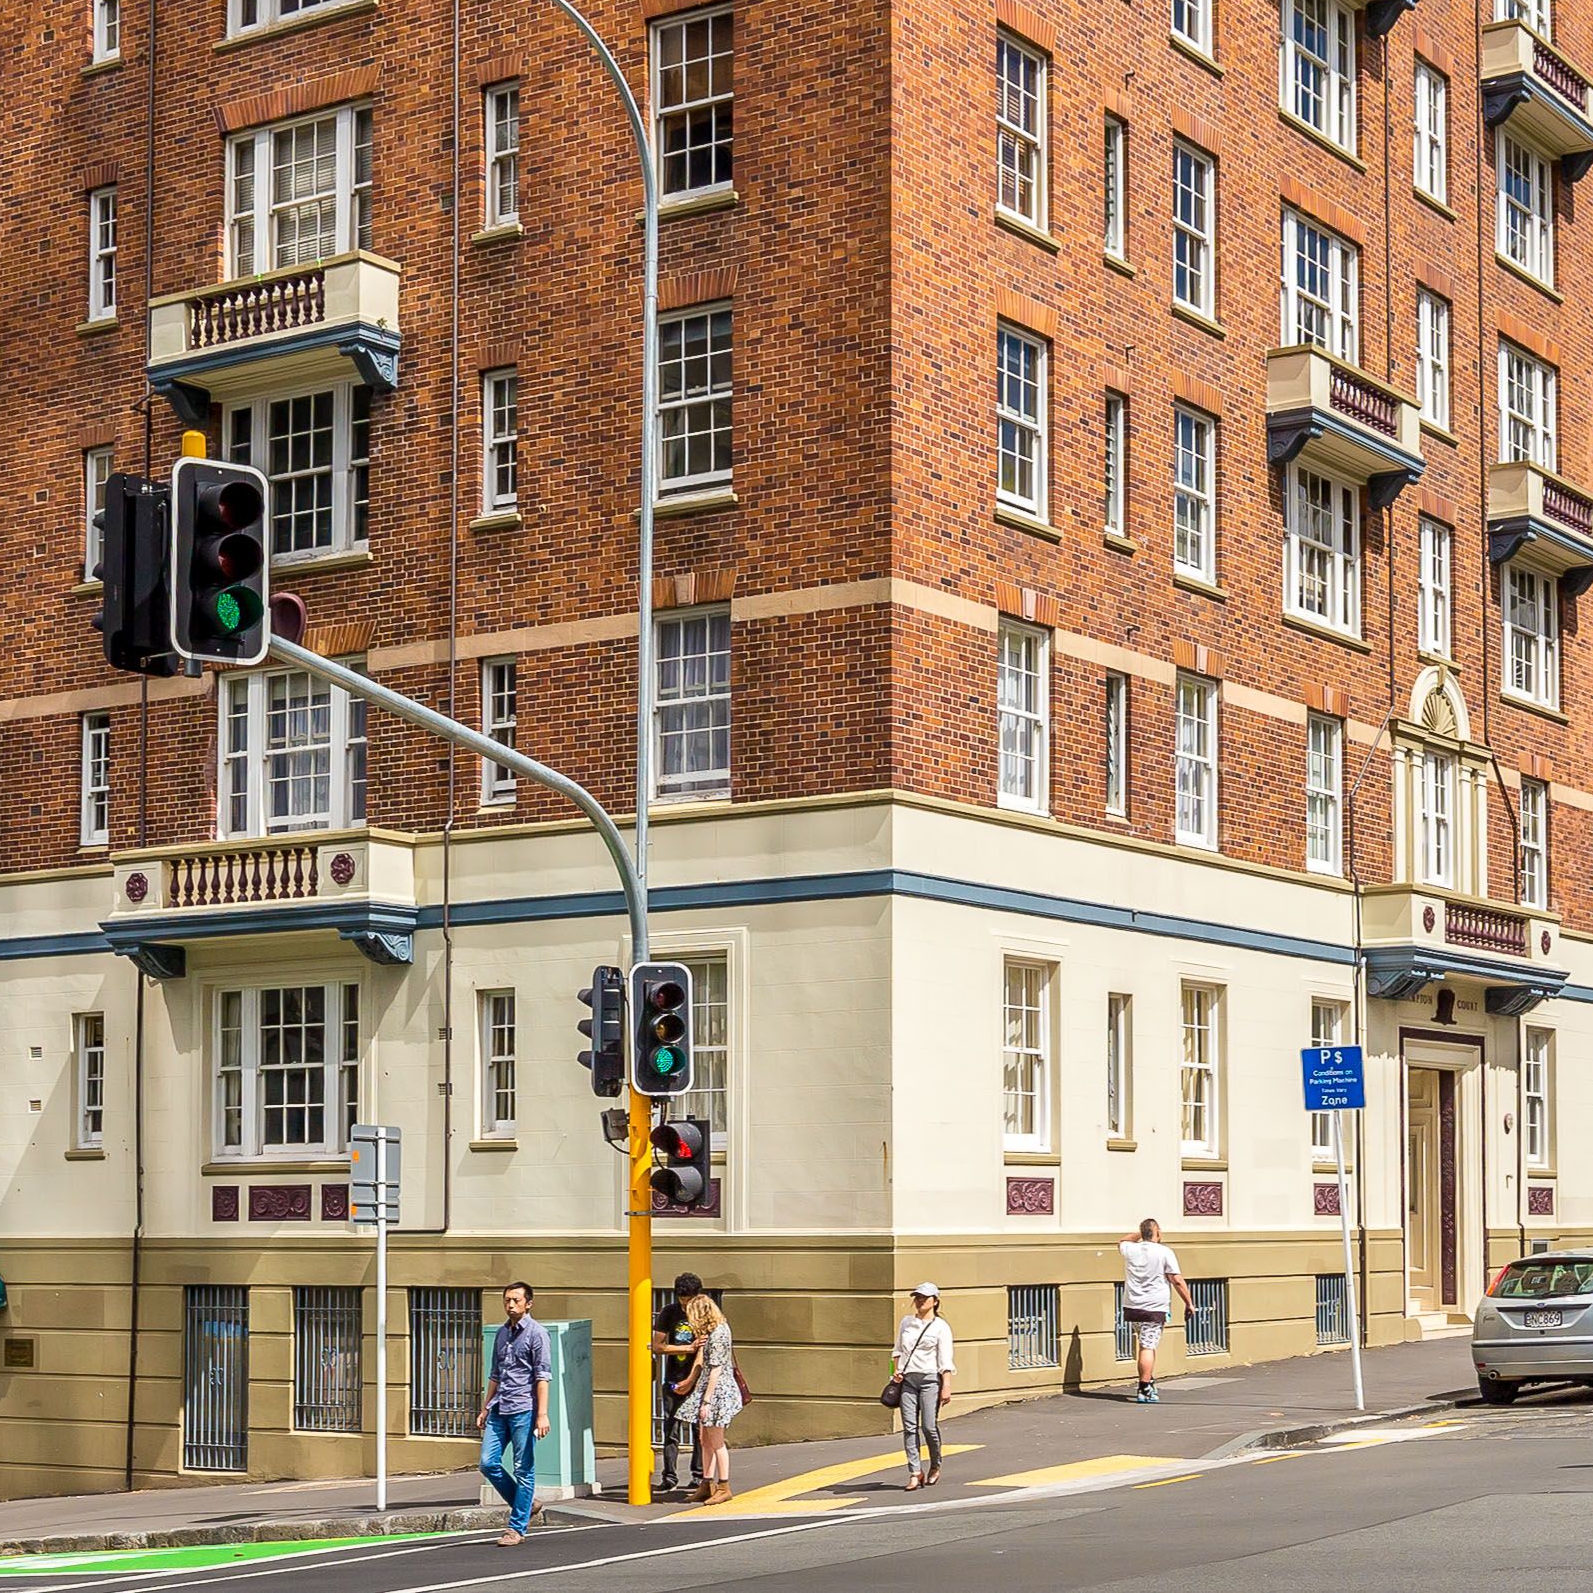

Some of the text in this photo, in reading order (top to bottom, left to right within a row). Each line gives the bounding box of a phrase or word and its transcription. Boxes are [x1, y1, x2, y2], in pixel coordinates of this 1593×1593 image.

[1456, 999, 1478, 1011] COURT
[1320, 1049, 1343, 1065] P $
[1321, 1095, 1348, 1106] Zone
